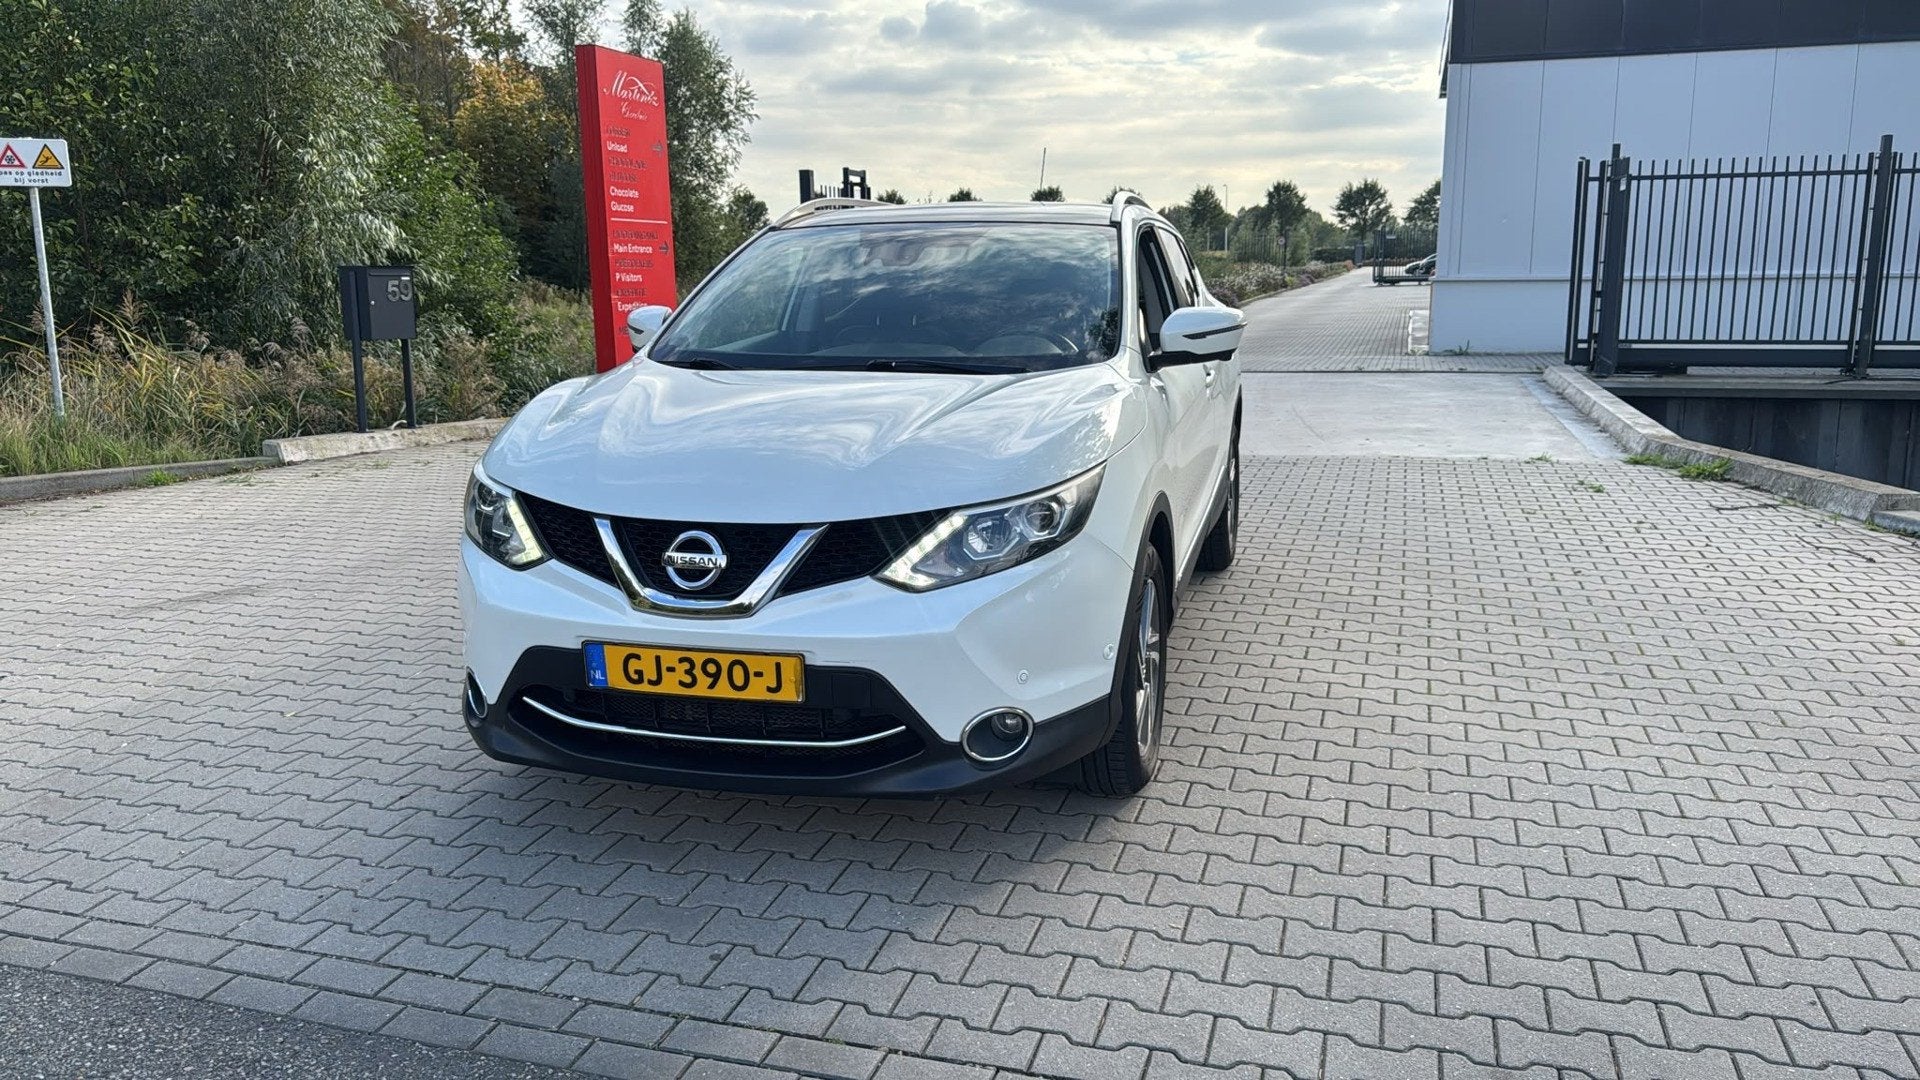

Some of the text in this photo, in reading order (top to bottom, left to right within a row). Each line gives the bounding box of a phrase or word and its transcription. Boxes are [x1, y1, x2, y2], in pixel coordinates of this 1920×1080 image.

[606, 140, 628, 153] Unload
[609, 185, 639, 198] Chocolate
[610, 200, 634, 212] Glucose
[613, 242, 653, 254] Main Entrance
[615, 272, 643, 282] P Visitors
[387, 280, 413, 301] 59
[664, 554, 718, 567] NISSAN
[590, 670, 605, 679] NL
[622, 653, 783, 694] GJ-390-J
